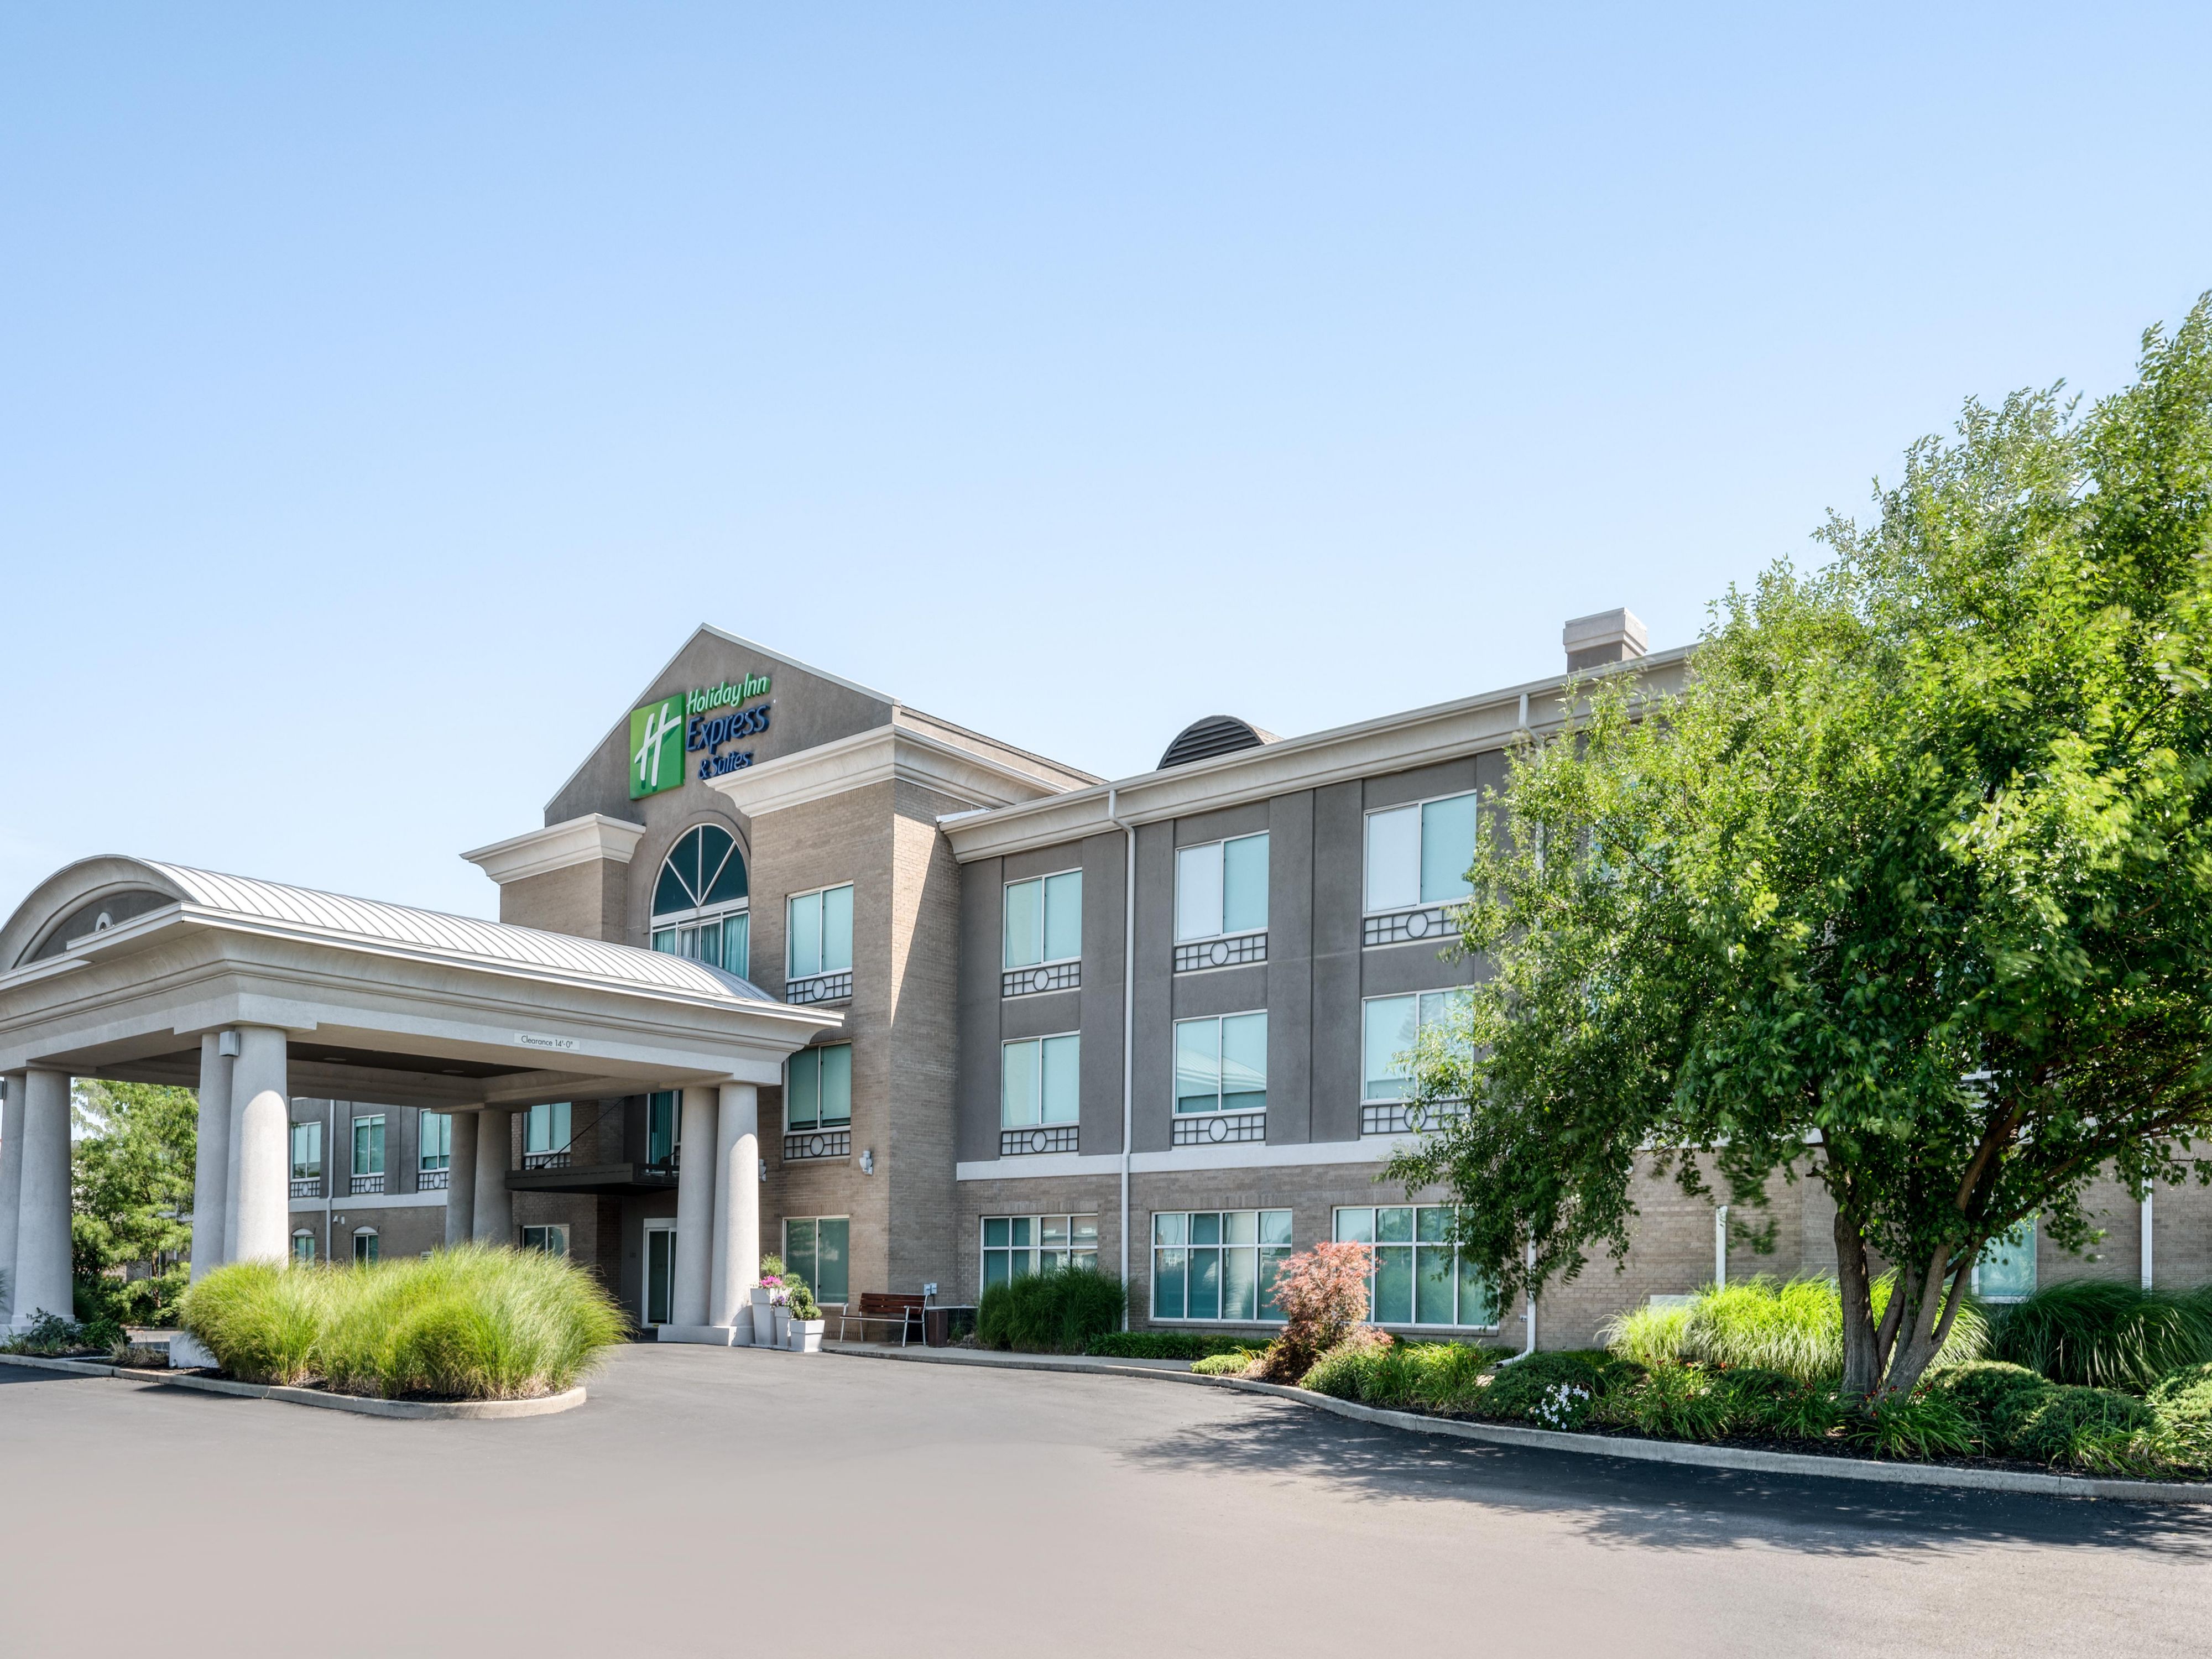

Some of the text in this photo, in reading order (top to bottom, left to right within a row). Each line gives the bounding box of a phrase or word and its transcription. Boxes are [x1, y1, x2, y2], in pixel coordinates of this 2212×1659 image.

[686, 672, 771, 714] Holiday Inn
[686, 705, 770, 754] Express
[698, 752, 753, 779] & Suites
[521, 1035, 552, 1046] Clearance
